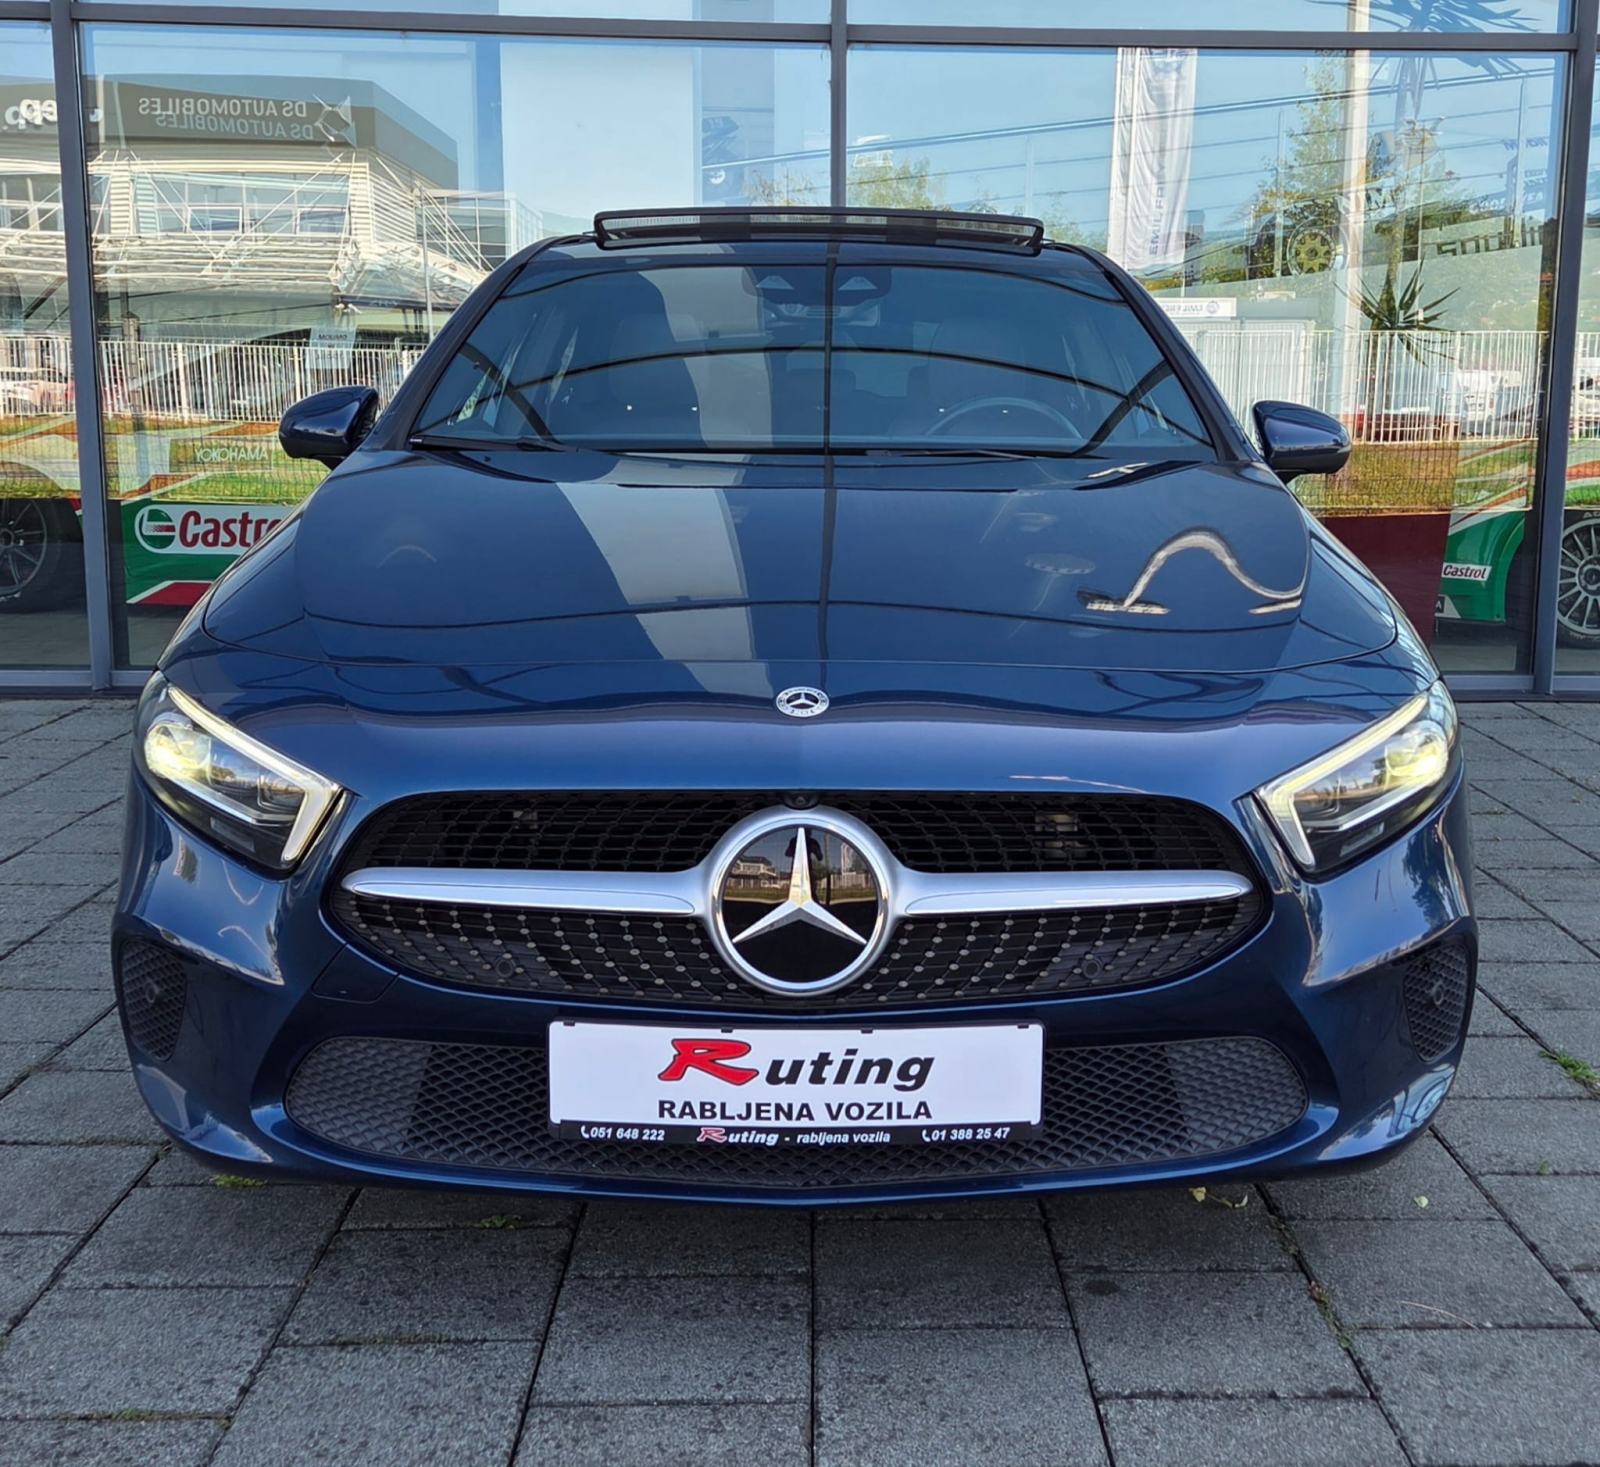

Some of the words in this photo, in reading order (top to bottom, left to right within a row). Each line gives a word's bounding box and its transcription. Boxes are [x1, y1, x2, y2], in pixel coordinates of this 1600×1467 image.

[195, 447, 269, 462] YOKOHAMA
[1443, 565, 1487, 579] Castrol
[658, 1038, 935, 1092] Ruting
[658, 1100, 815, 1121] RABLJENA
[825, 1101, 932, 1121] VOZILA
[590, 1127, 612, 1139] 051
[616, 1128, 639, 1140] 648
[642, 1129, 665, 1141] 222
[697, 1127, 779, 1146] Ruting
[797, 1131, 849, 1146] rabljena
[853, 1131, 891, 1143] vozila
[931, 1129, 946, 1141] 01
[950, 1129, 973, 1141] 388
[976, 1128, 992, 1139] 25
[994, 1127, 1011, 1139] 47
